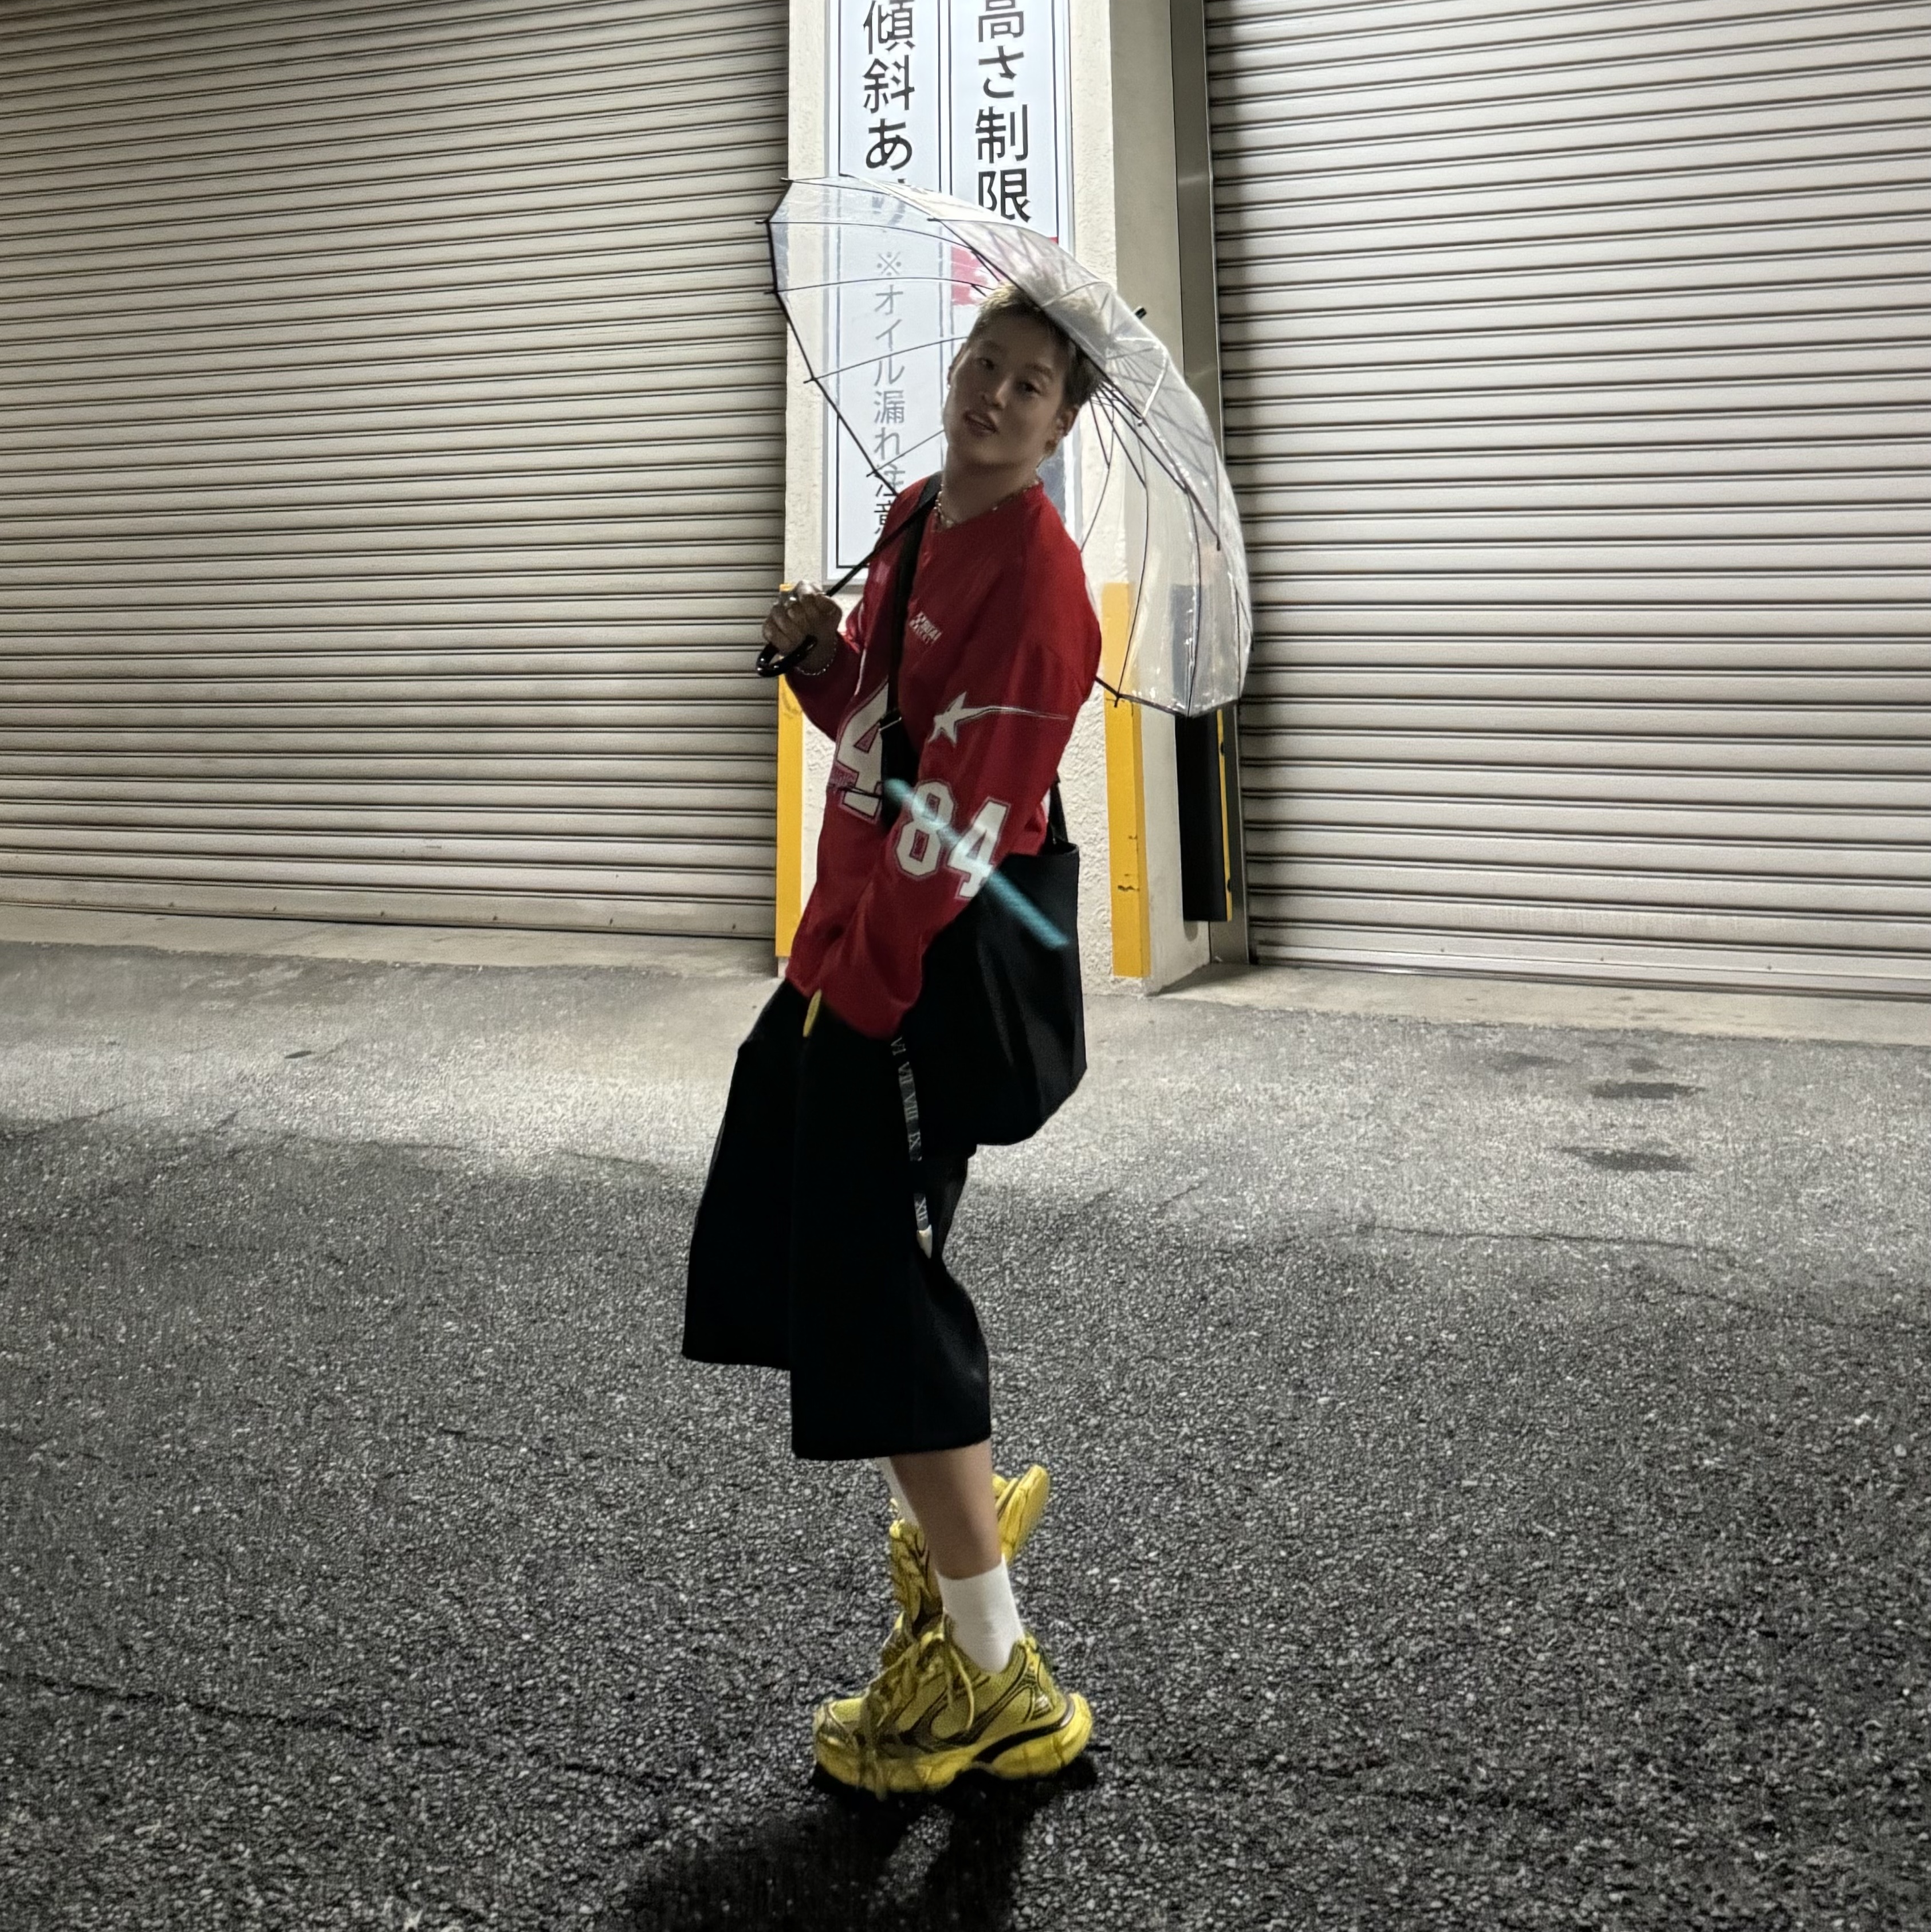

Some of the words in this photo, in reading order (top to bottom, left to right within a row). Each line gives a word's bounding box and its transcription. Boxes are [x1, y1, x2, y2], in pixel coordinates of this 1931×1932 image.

[976, 0, 1032, 223] 高さ制限
[894, 779, 1012, 900] 84
